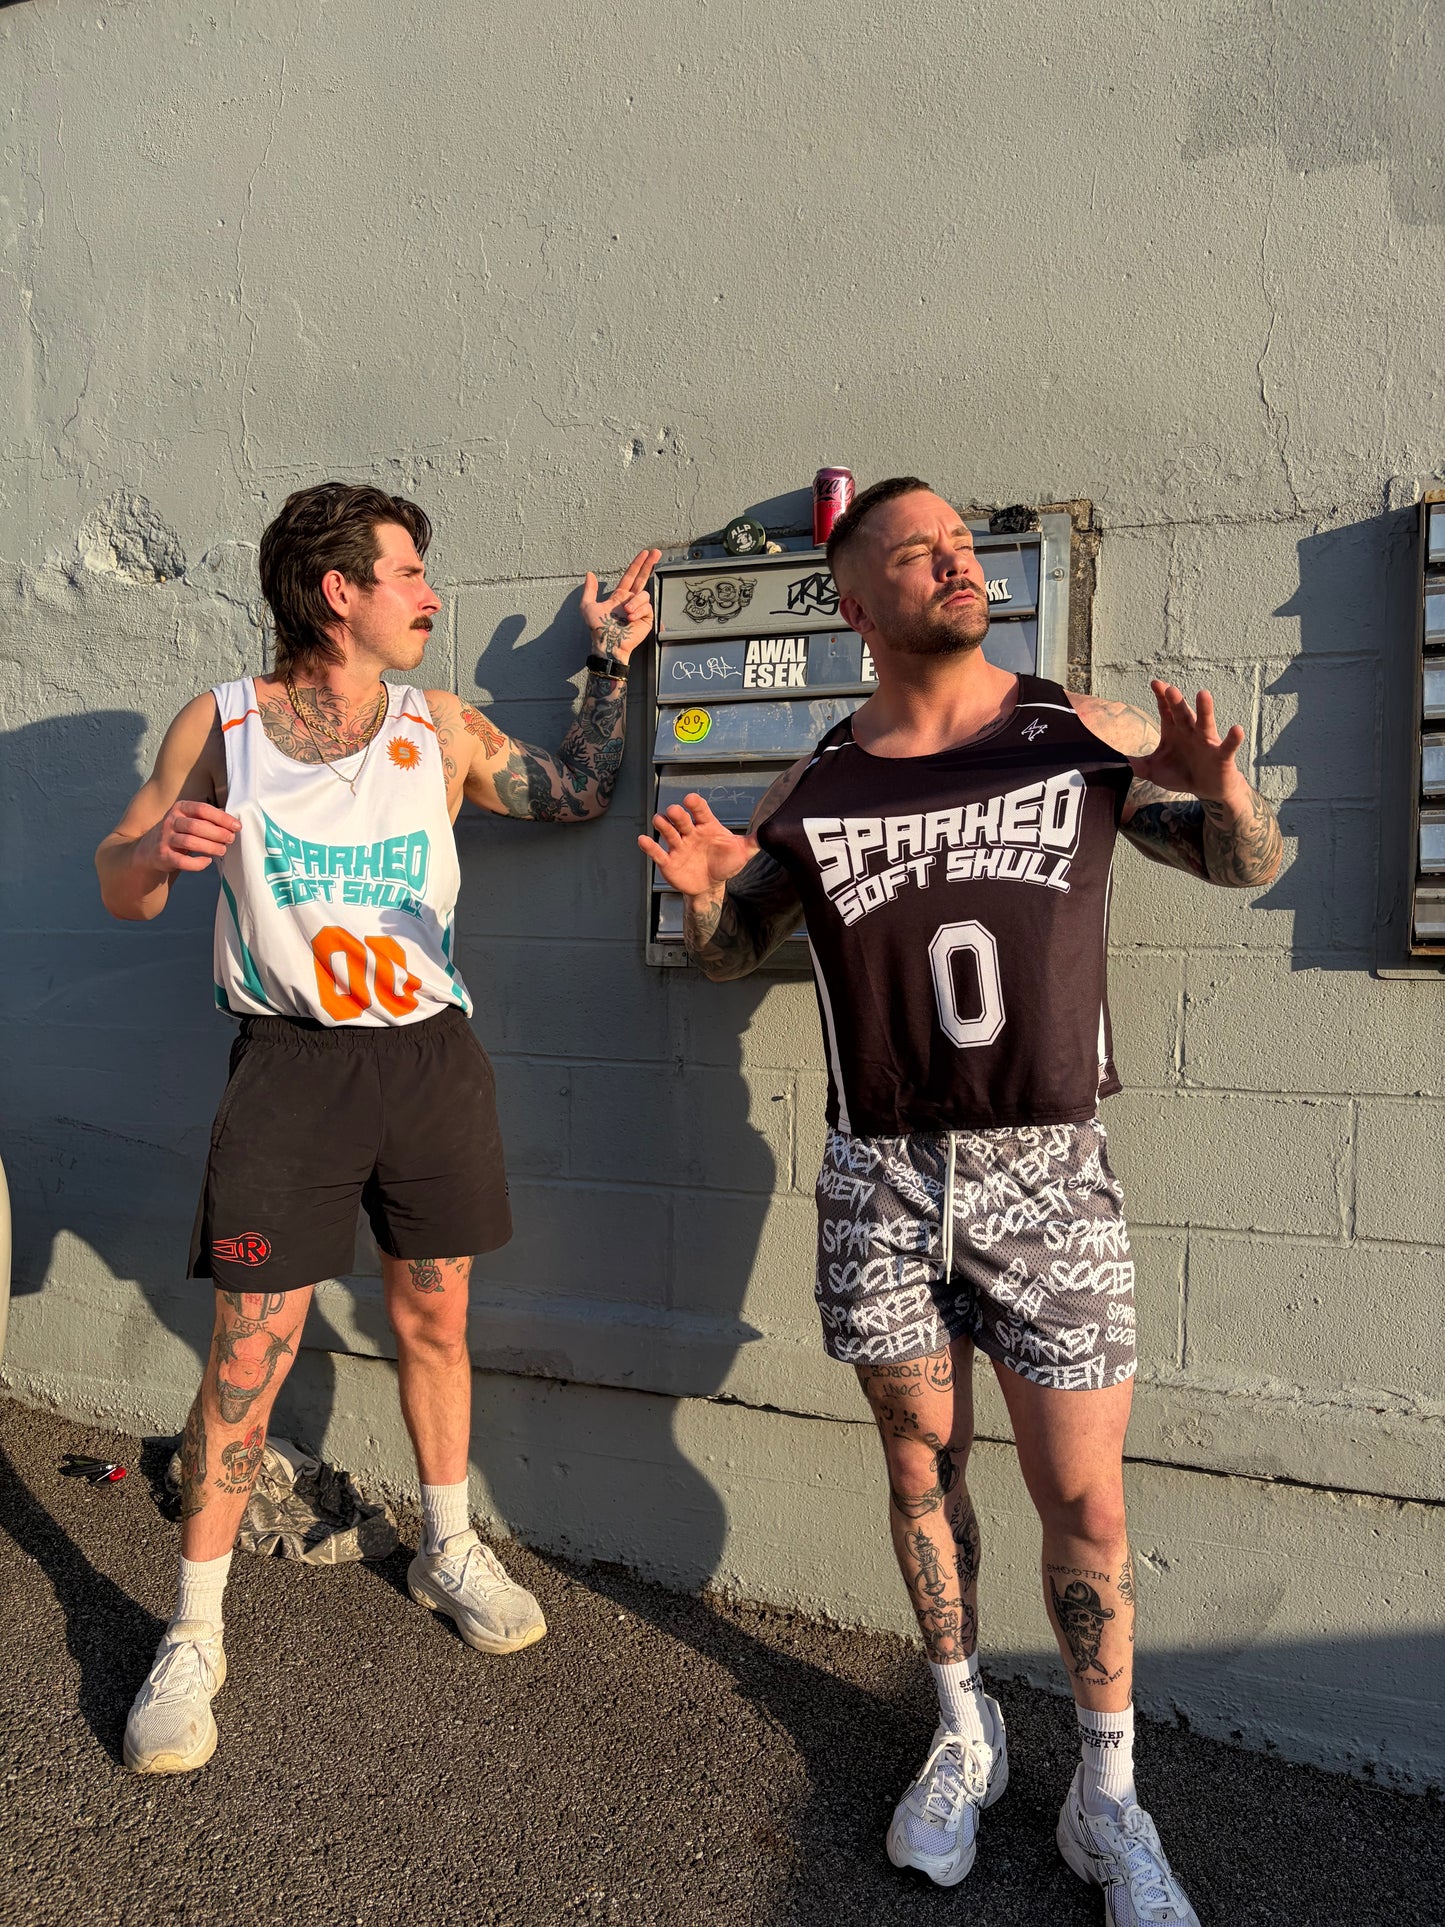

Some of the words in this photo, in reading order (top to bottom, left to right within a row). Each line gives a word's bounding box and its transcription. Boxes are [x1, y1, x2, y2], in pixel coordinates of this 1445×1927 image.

[731, 524, 751, 539] ALP
[746, 638, 807, 664] AWAL
[743, 663, 807, 688] ESEK
[834, 856, 936, 926] SOFT
[928, 920, 1006, 1048] 0
[233, 1320, 269, 1333] DECAF
[213, 1478, 226, 1488] TIP
